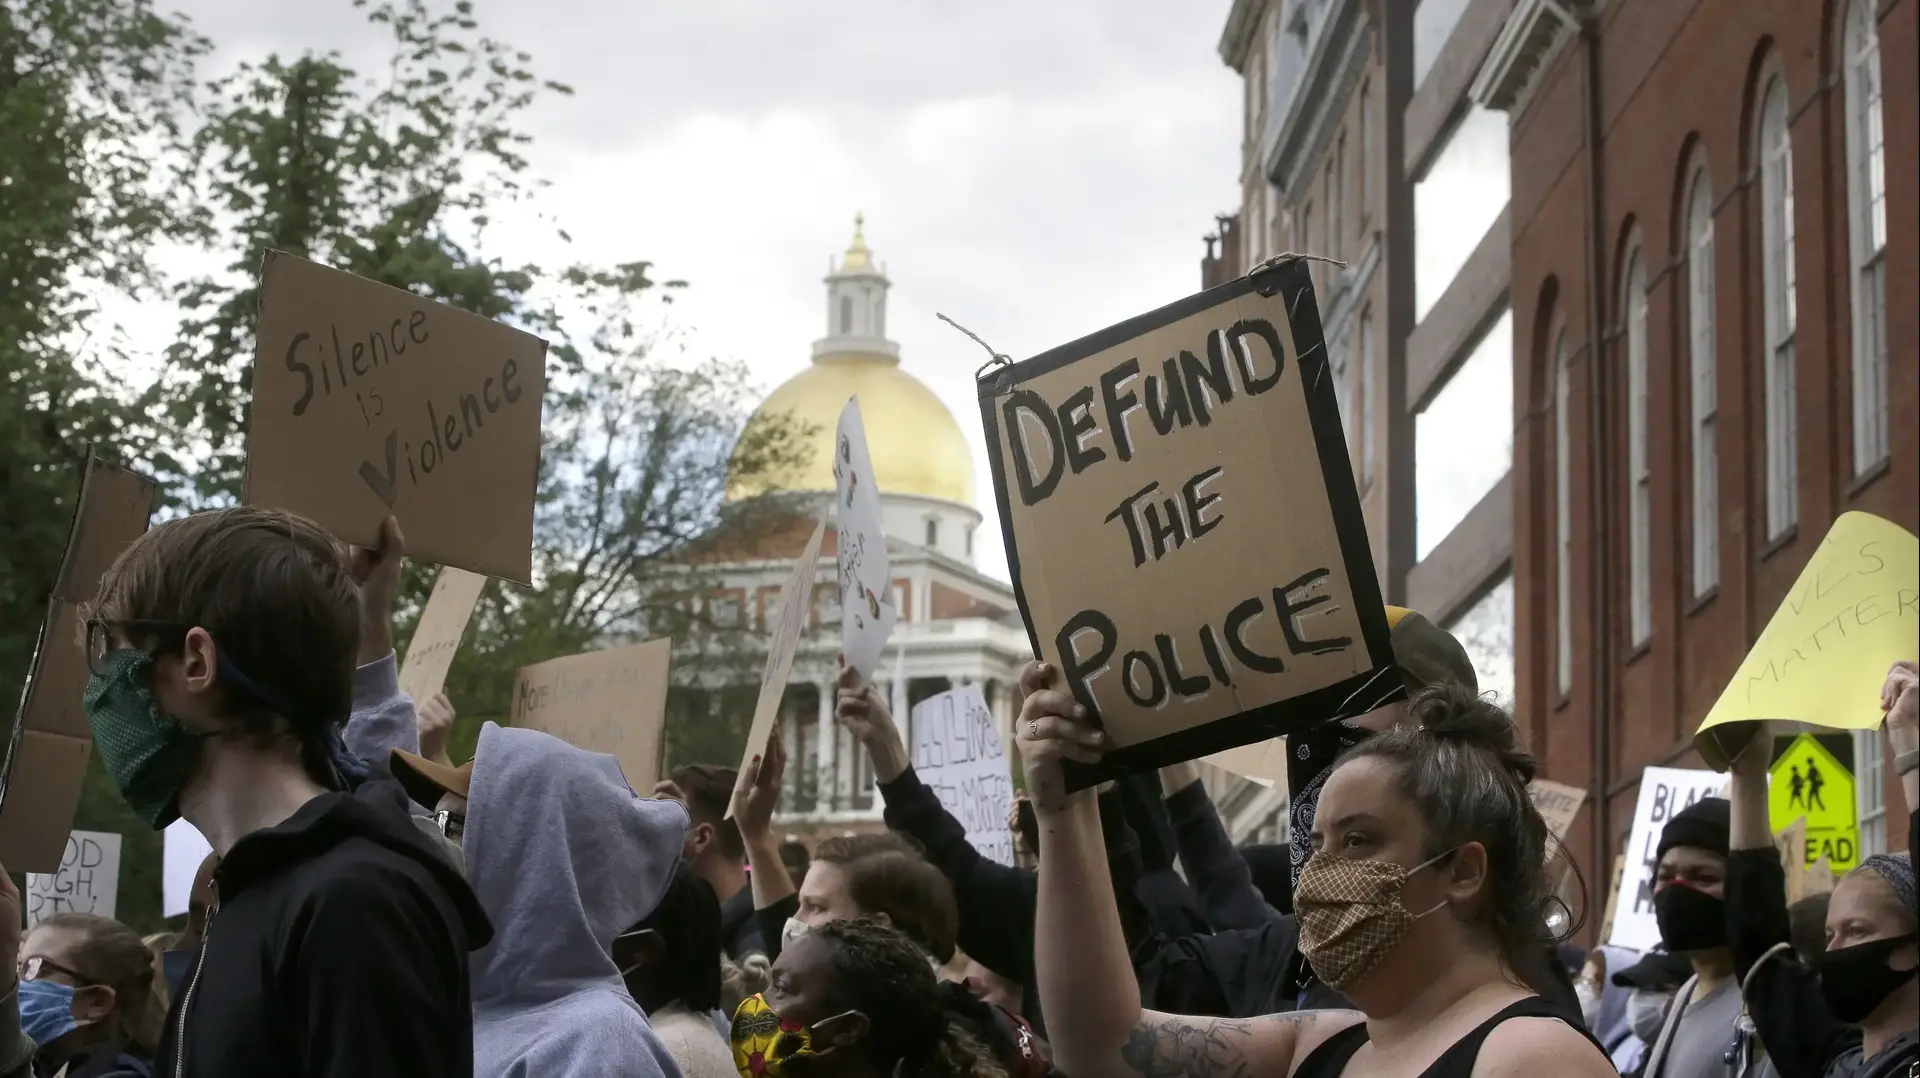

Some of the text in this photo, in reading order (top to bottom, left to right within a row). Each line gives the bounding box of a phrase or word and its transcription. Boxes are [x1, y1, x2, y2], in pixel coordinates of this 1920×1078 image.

[285, 310, 429, 416] Silence
[358, 358, 522, 510] Violence
[1003, 318, 1285, 506] DEFUND
[1104, 465, 1224, 568] THE
[1055, 567, 1352, 729] POLICE
